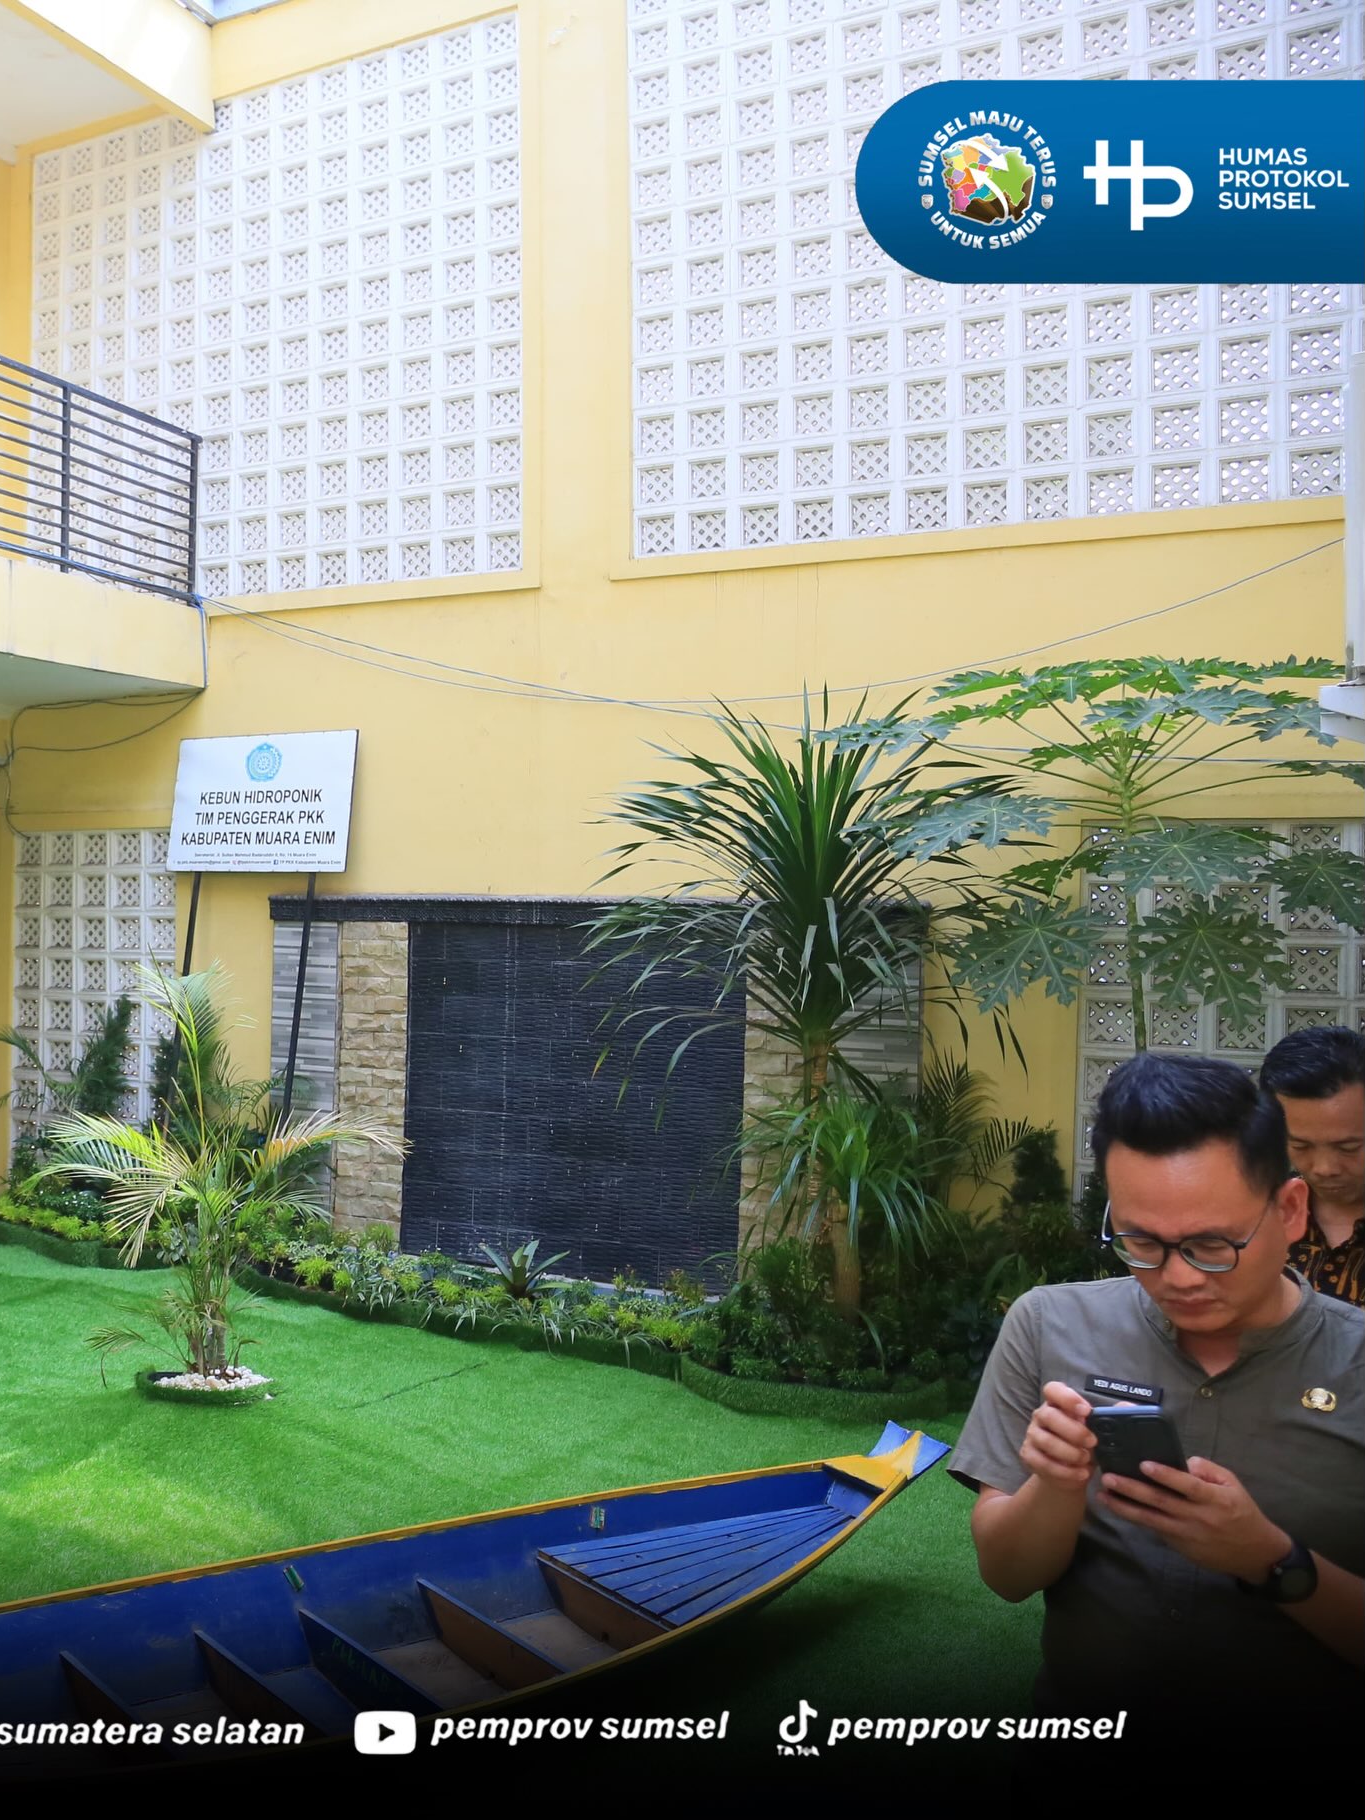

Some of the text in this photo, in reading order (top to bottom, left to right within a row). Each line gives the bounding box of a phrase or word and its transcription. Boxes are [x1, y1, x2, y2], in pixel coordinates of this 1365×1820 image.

[200, 789, 322, 805] KEBUN HIDROPONIK
[195, 810, 325, 825] TIM PENGGERAK PKK
[181, 830, 336, 846] KABUPATEN MUARA ENIM
[1109, 1382, 1128, 1393] AGUS
[1128, 1385, 1153, 1397] LANDO
